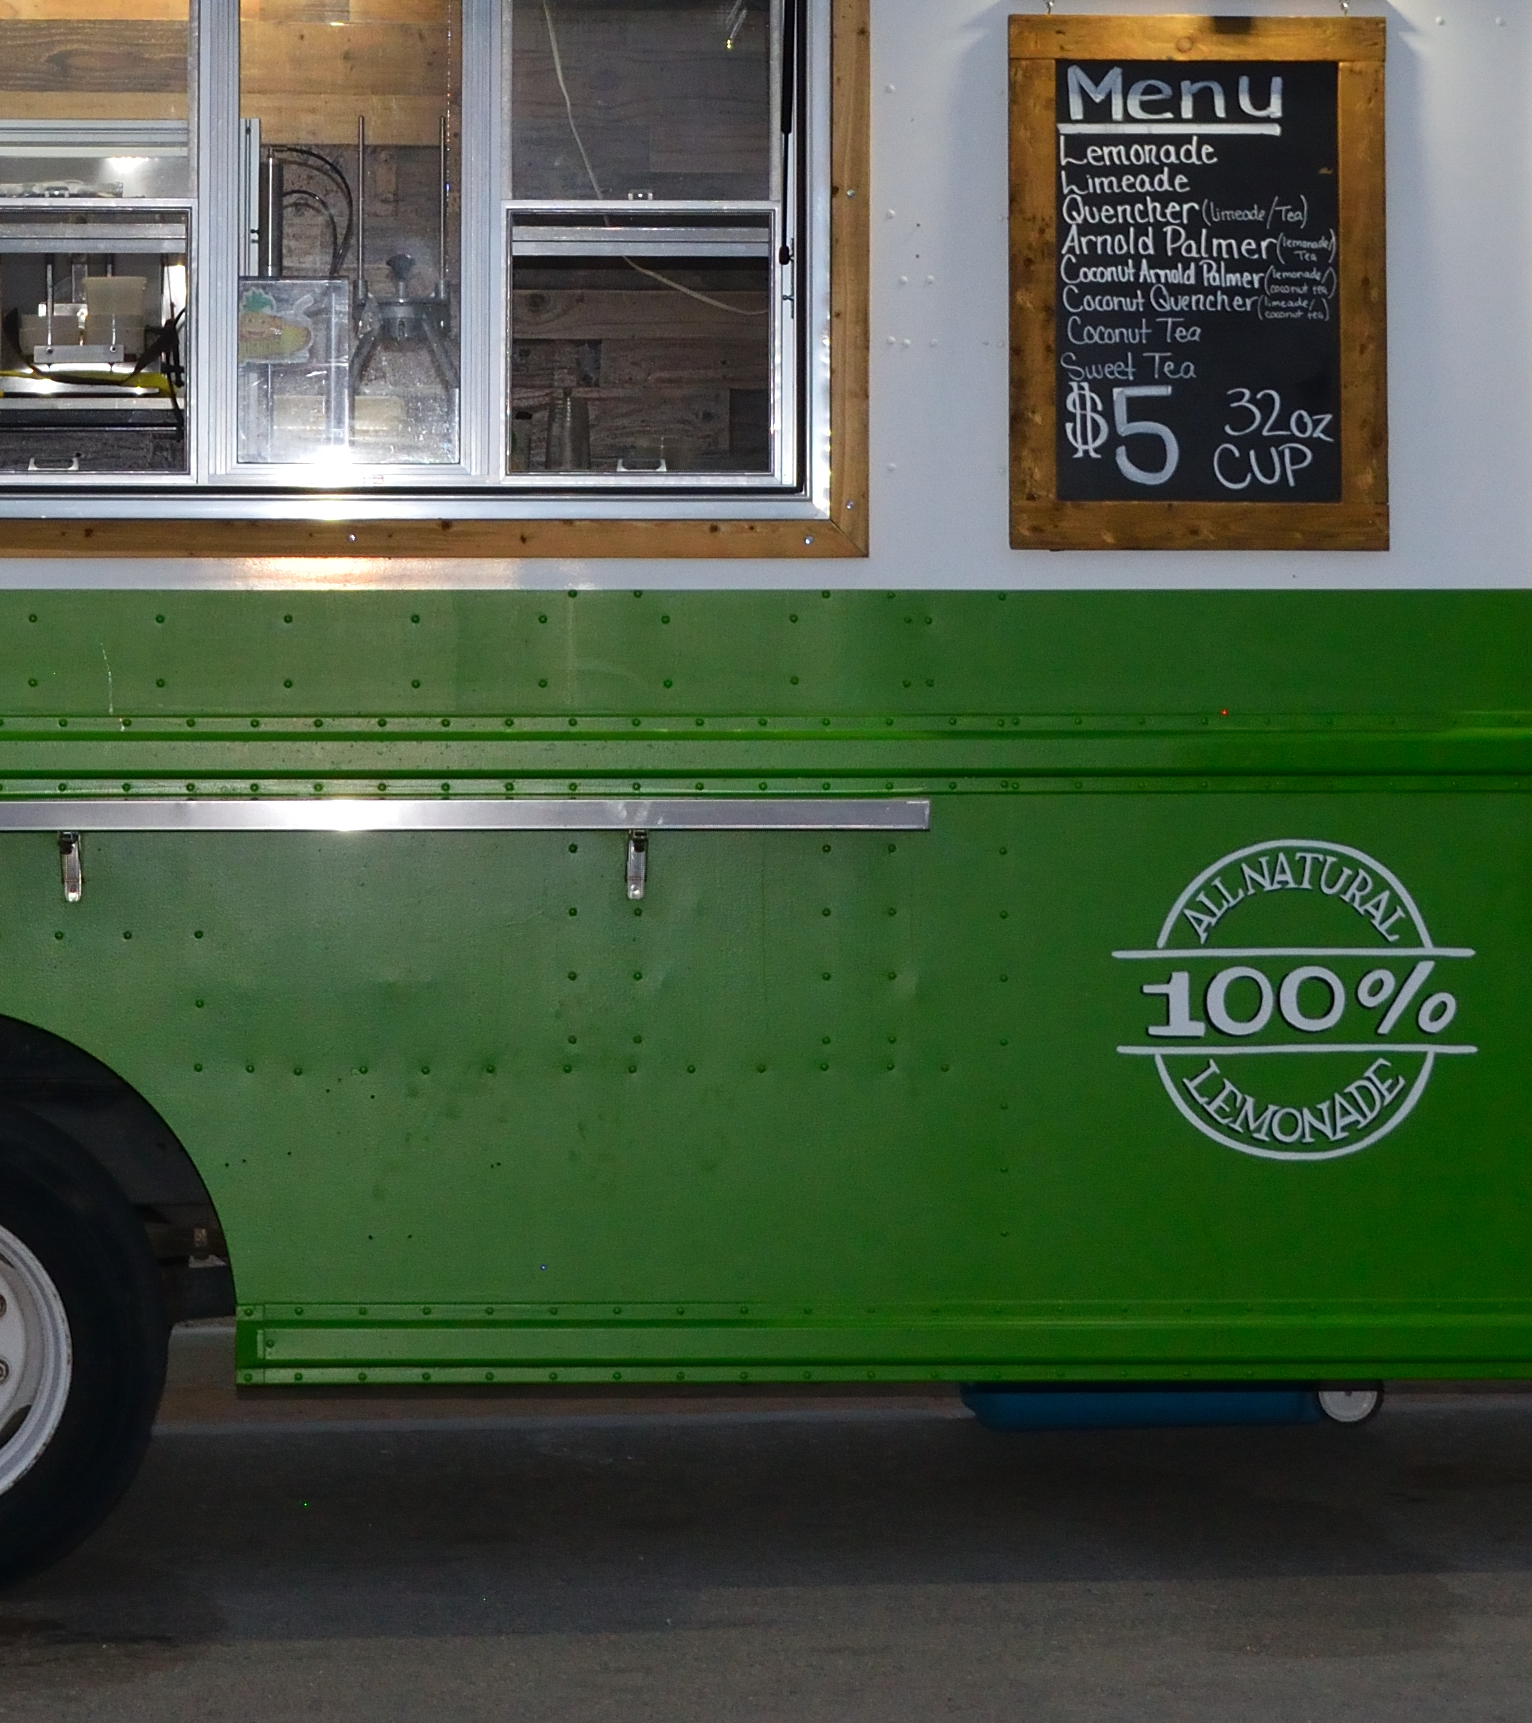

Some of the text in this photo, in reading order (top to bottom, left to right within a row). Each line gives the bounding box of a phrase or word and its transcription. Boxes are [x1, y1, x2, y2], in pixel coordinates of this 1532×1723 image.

[1067, 64, 1283, 122] Menu
[1060, 135, 1218, 166] Lemonade
[1061, 166, 1191, 195] Limeade
[1062, 194, 1199, 225] Quencher
[1061, 224, 1155, 255] Arnold
[1163, 226, 1277, 259] Palmer
[1061, 254, 1136, 284] Coconut
[1139, 258, 1196, 284] Arnold
[1199, 259, 1265, 288] Palmer
[1063, 285, 1145, 313] Coconut
[1150, 283, 1259, 313] Quencher
[1068, 316, 1202, 344] Coconut Tea
[1061, 352, 1197, 381] Sweet Tea
[1214, 442, 1313, 490] CUP
[1142, 960, 1457, 1038] 100%
[1182, 1058, 1406, 1144] LEMONADE
